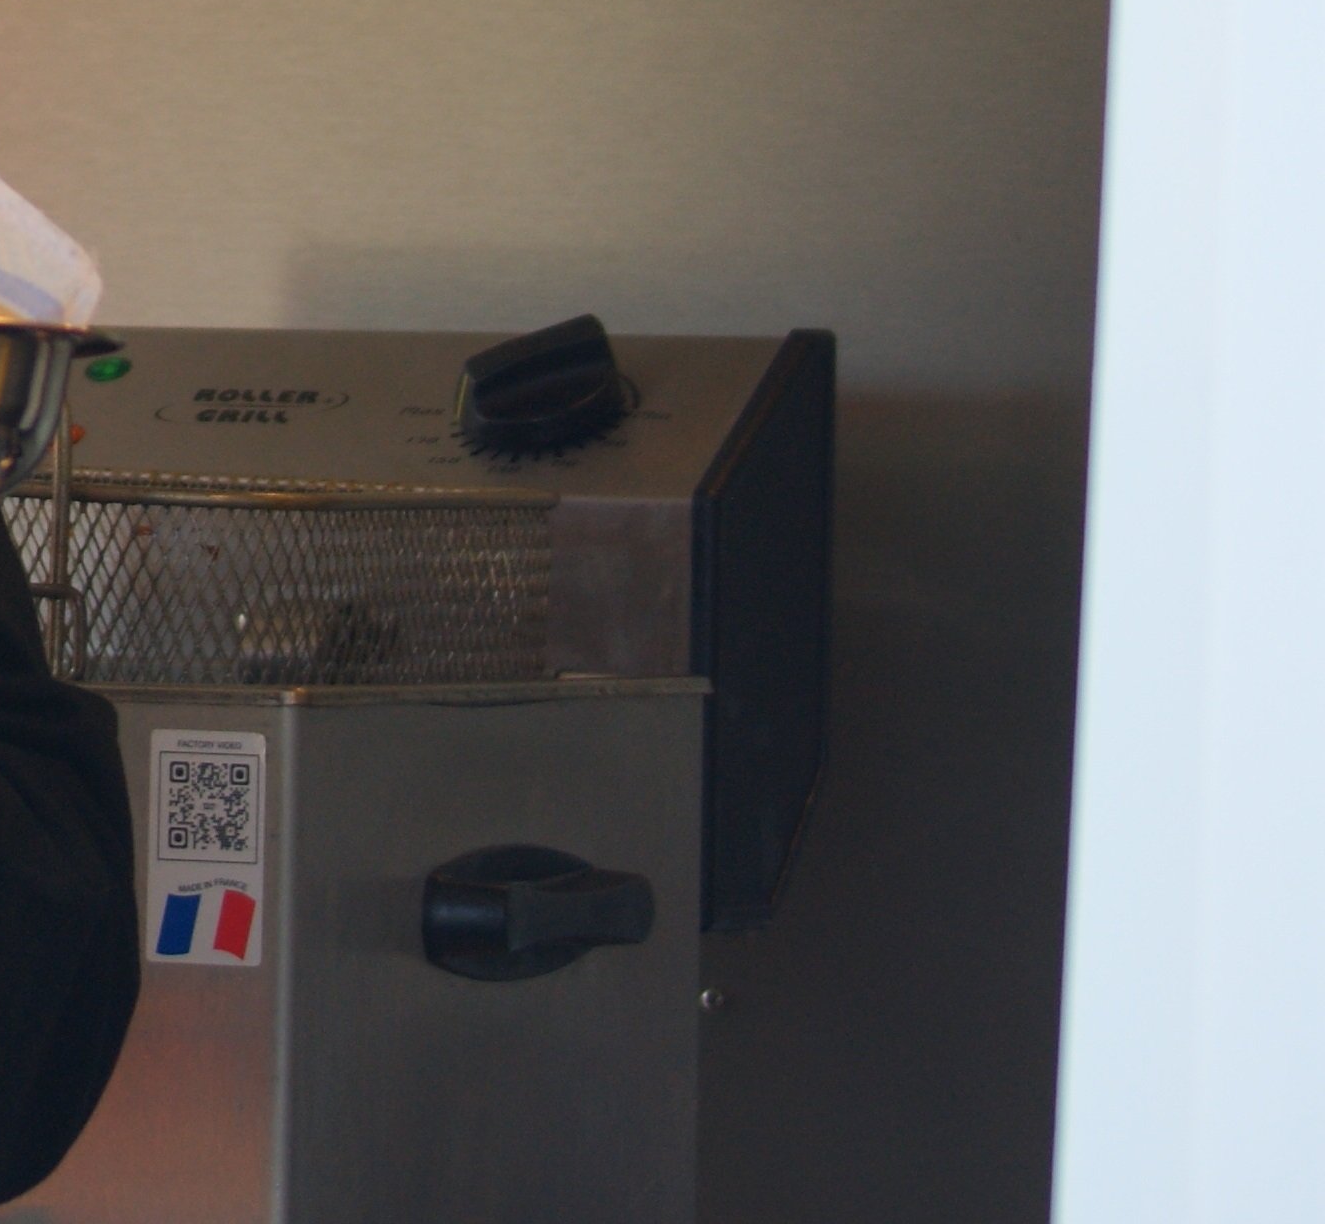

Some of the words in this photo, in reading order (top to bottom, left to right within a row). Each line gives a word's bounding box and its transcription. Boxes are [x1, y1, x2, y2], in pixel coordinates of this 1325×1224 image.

[193, 388, 320, 405] ROLLER
[195, 408, 290, 424] GRILL
[177, 739, 214, 749] FACTORY
[217, 741, 243, 750] VIDEO
[177, 883, 202, 893] MADE
[203, 881, 213, 889] IN
[213, 877, 248, 891] FRANCE
